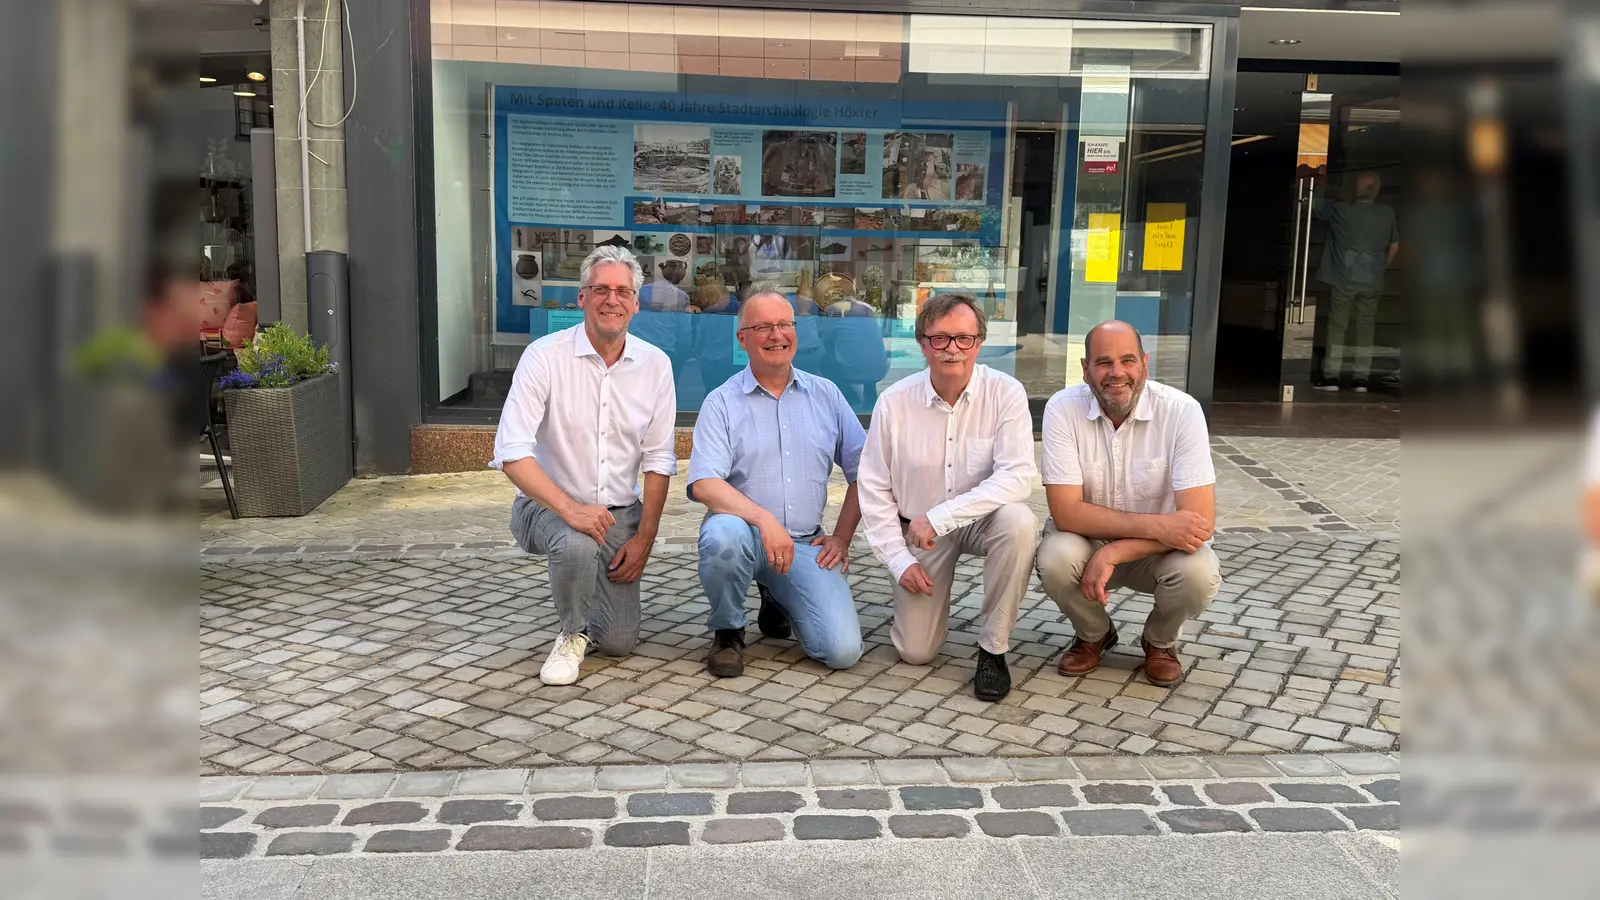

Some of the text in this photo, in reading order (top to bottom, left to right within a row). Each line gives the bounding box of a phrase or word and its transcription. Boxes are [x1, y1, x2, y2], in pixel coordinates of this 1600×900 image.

[510, 92, 878, 120] Mit Spaten und Kelle: 40 Jahre Stadtarchäologie Höxter
